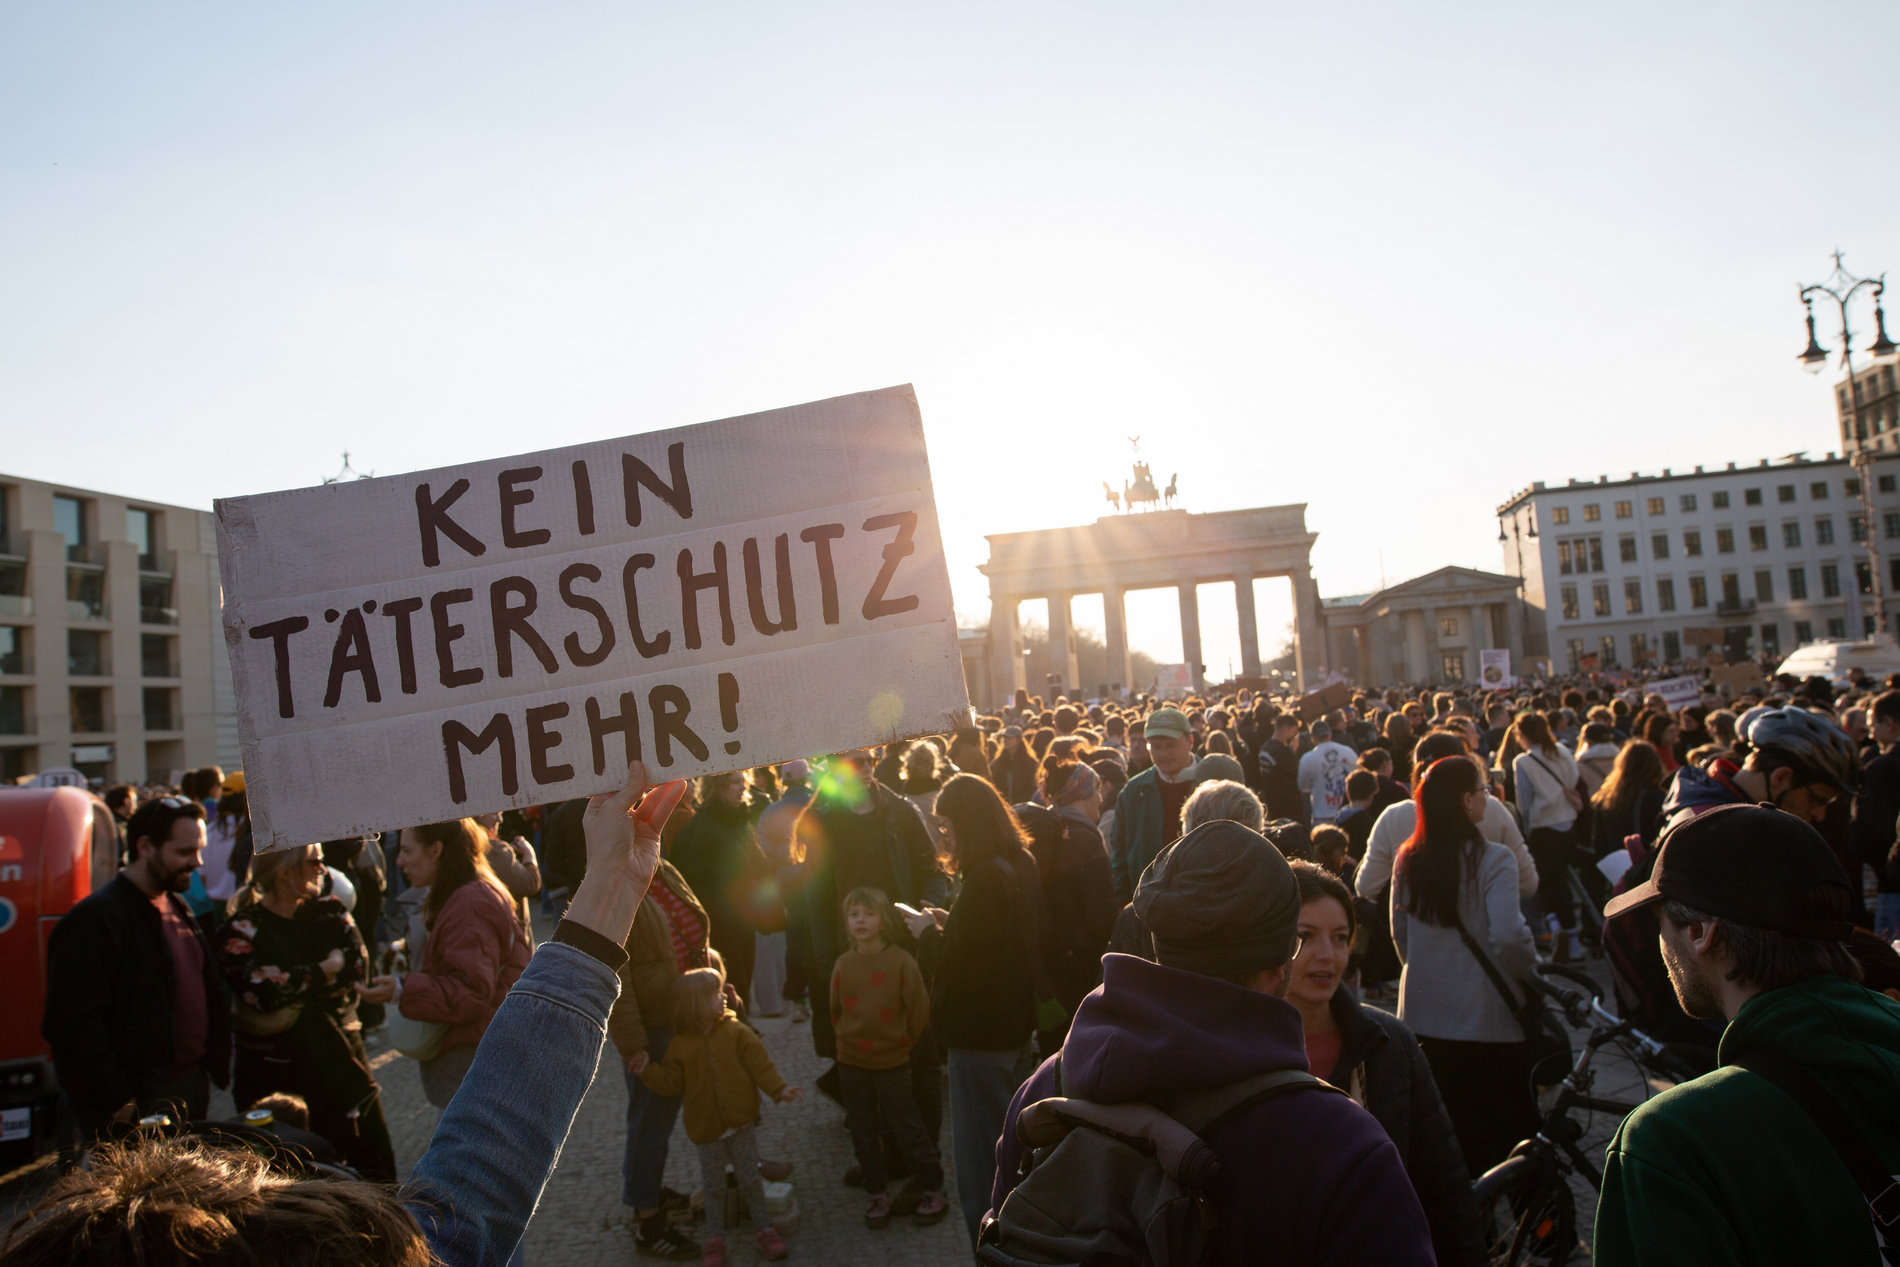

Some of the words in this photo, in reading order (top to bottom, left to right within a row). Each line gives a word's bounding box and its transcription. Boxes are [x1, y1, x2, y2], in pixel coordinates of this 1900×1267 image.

[414, 441, 694, 568] KEIN
[248, 510, 920, 720] TÄTERSCHUTZ
[441, 672, 741, 804] MEHR!
[0, 863, 22, 882] n
